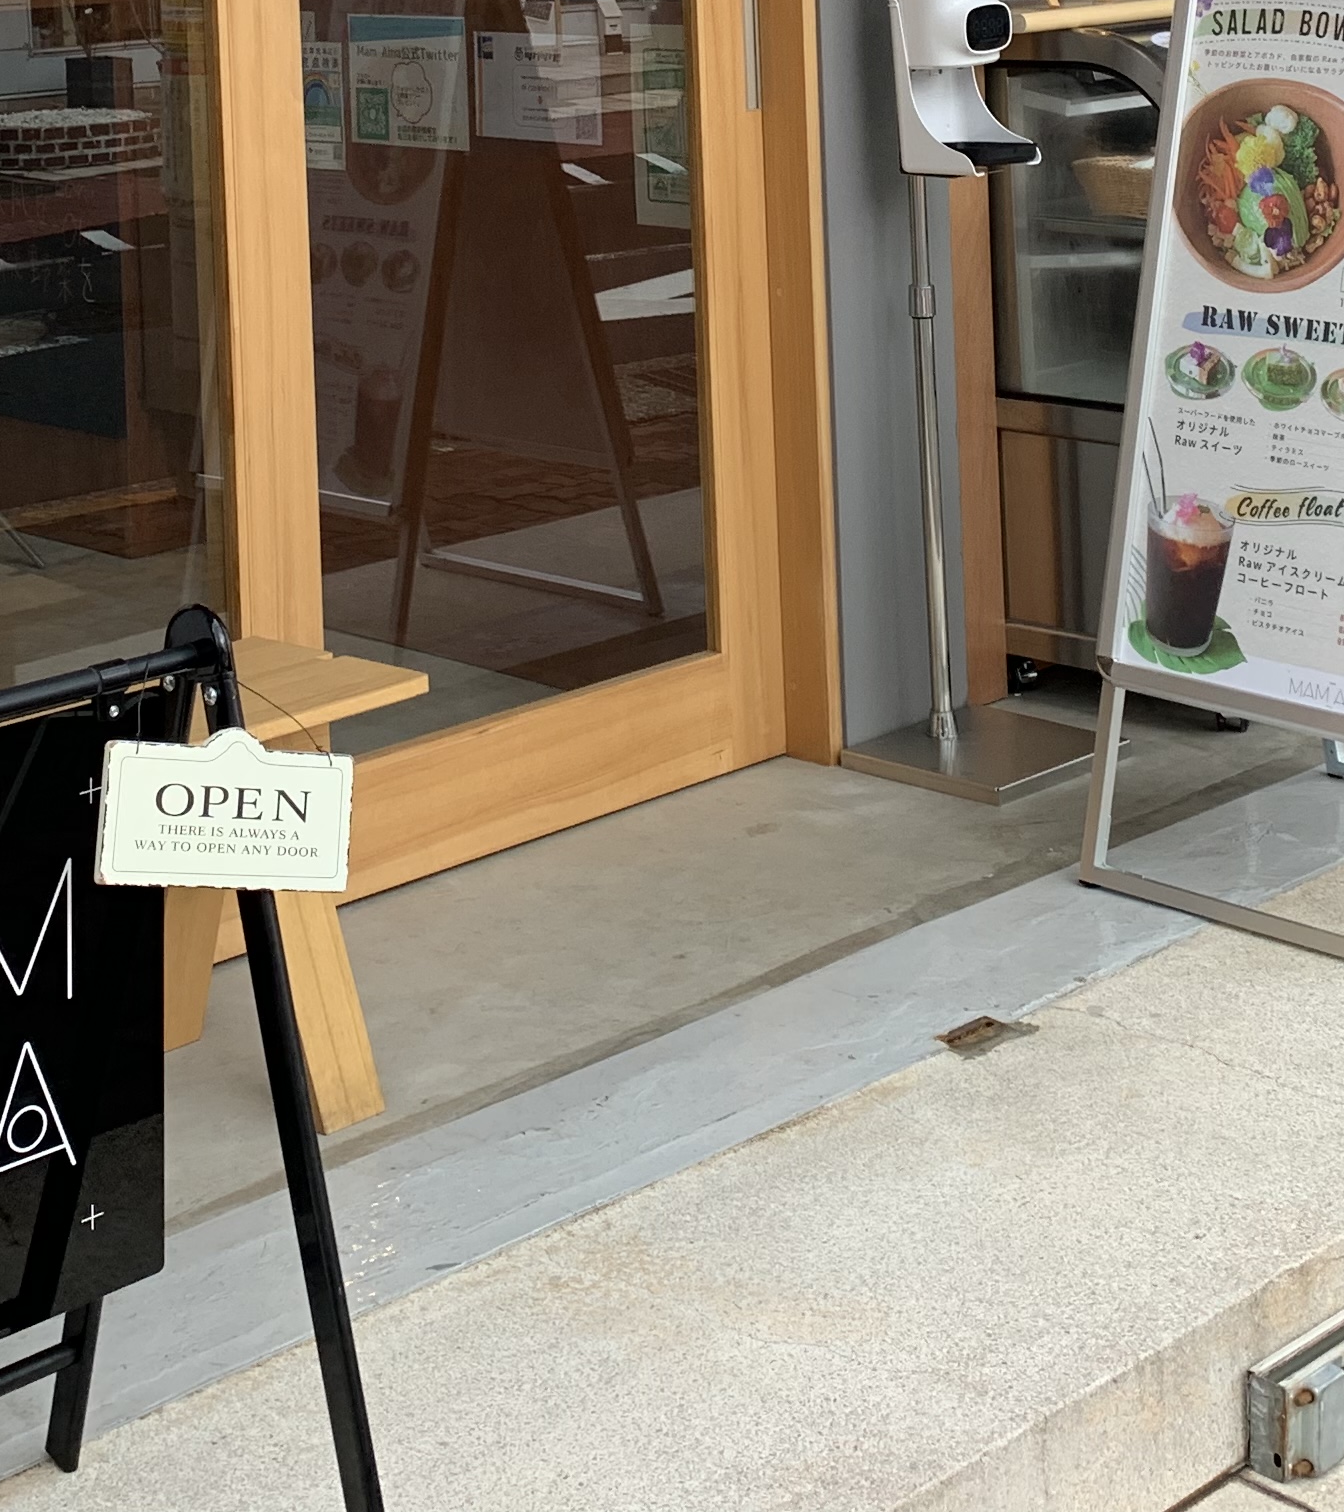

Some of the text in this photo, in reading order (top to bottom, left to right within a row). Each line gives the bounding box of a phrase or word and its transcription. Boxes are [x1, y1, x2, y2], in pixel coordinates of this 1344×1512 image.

[1212, 9, 1285, 37] SALAD
[1201, 305, 1258, 333] RAW
[1178, 407, 1256, 427] スーパーフードを使用した
[1176, 420, 1229, 437] オリジナル
[1174, 435, 1242, 455] Raw スイーツ
[1237, 496, 1344, 520] Coffee float
[1240, 540, 1297, 560] オリジナル
[1238, 556, 1262, 570] Raw
[1237, 573, 1328, 600] コーヒーフロート
[1289, 678, 1330, 703] MAM
[155, 783, 312, 824] OPEN
[158, 824, 300, 840] THERE IS ALWAYS A
[134, 839, 318, 858] WAY TO OPEN ANY DOOR
